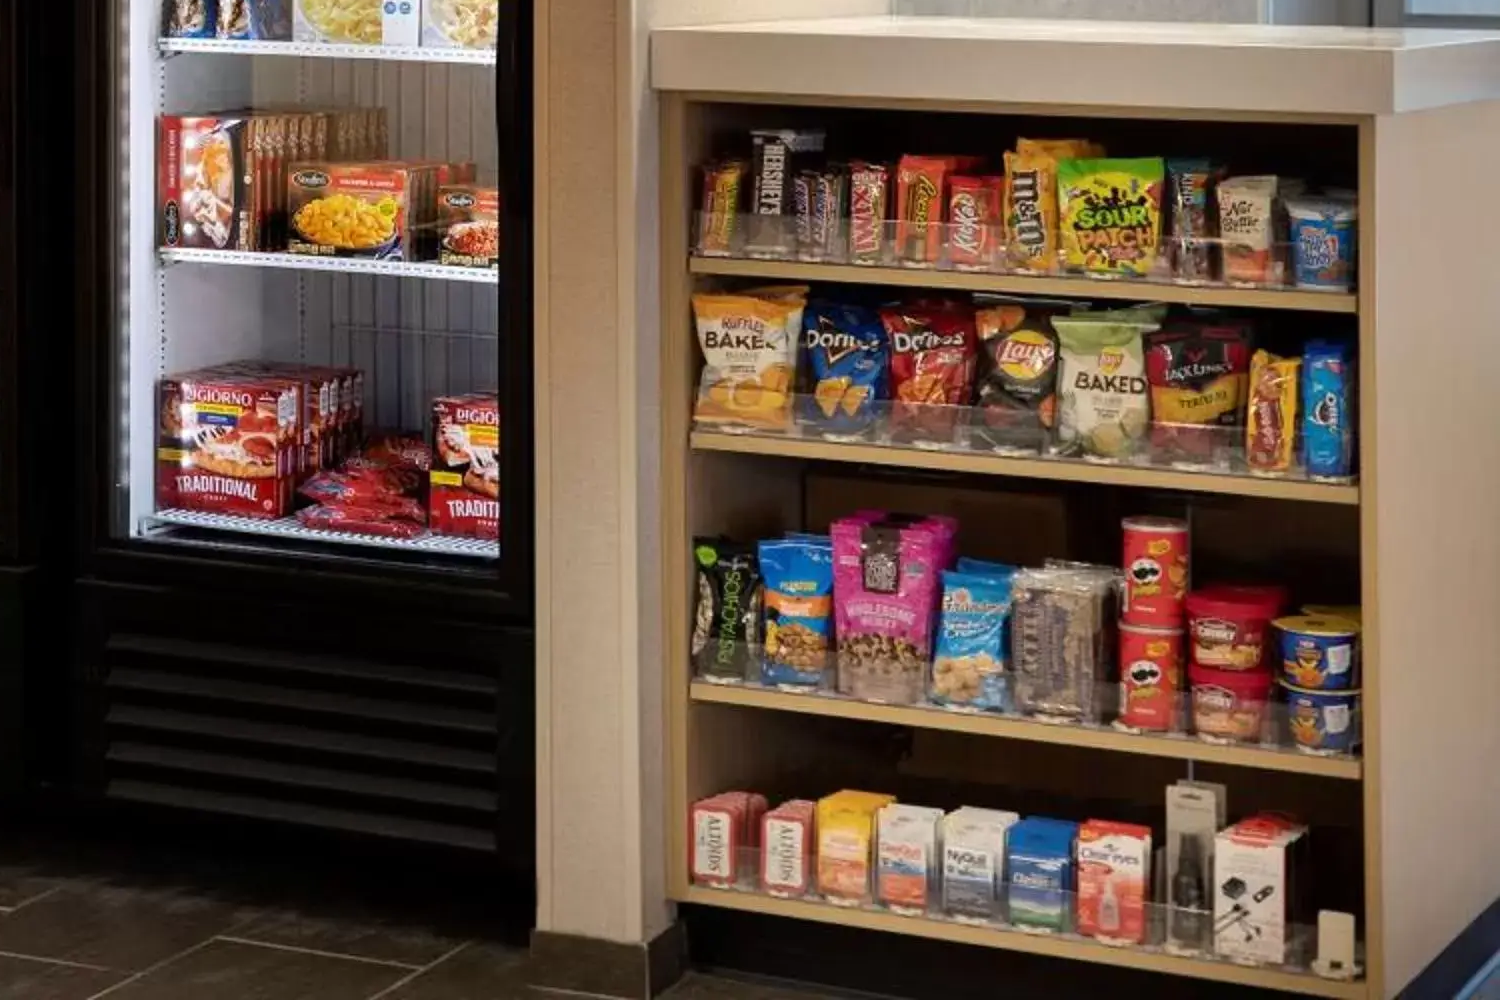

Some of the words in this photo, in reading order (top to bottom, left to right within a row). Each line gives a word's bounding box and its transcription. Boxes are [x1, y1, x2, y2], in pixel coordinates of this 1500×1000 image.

[1076, 205, 1148, 229] SOUR
[705, 331, 777, 351] BAKE
[1075, 371, 1146, 395] BAKED
[176, 475, 259, 501] TRADITIONAL
